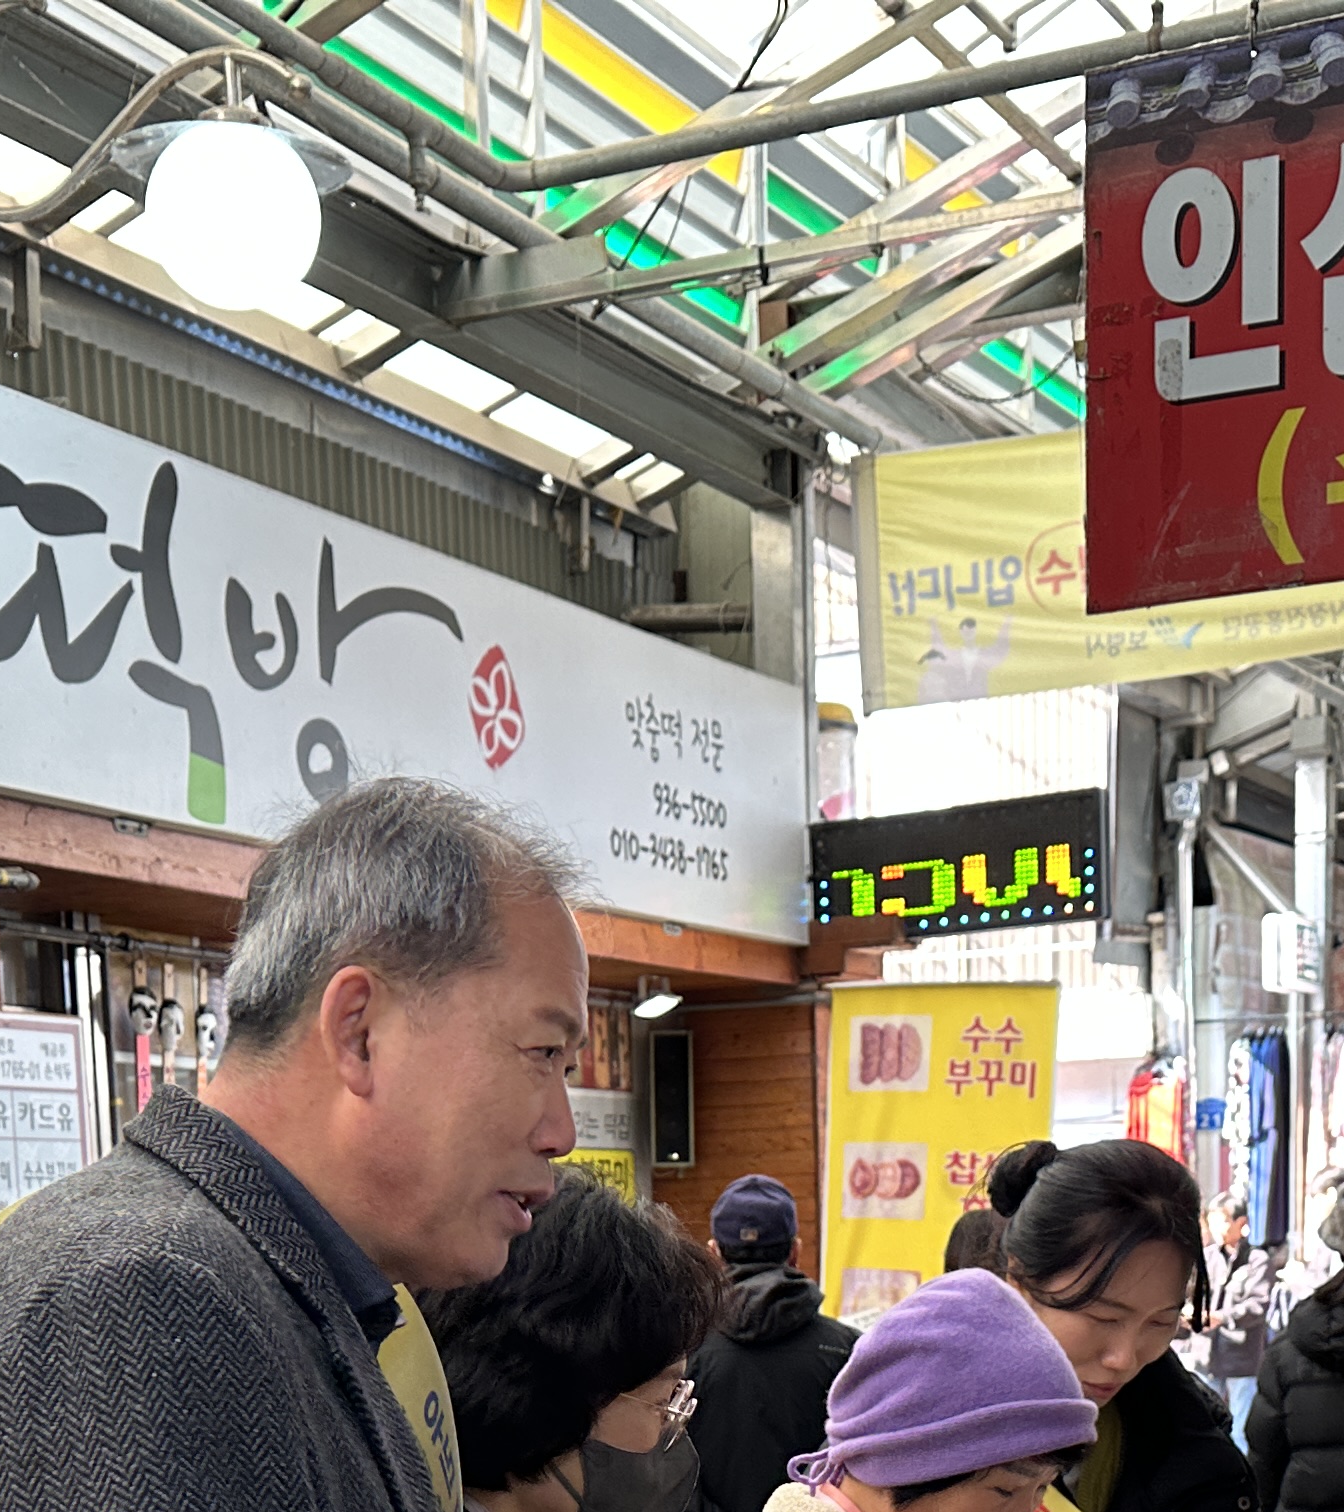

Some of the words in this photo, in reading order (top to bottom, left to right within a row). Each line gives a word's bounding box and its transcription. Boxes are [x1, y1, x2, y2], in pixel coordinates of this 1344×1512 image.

[691, 717, 725, 773] 전문
[961, 1016, 1024, 1054] 수수
[944, 1058, 1037, 1099] 부꾸미
